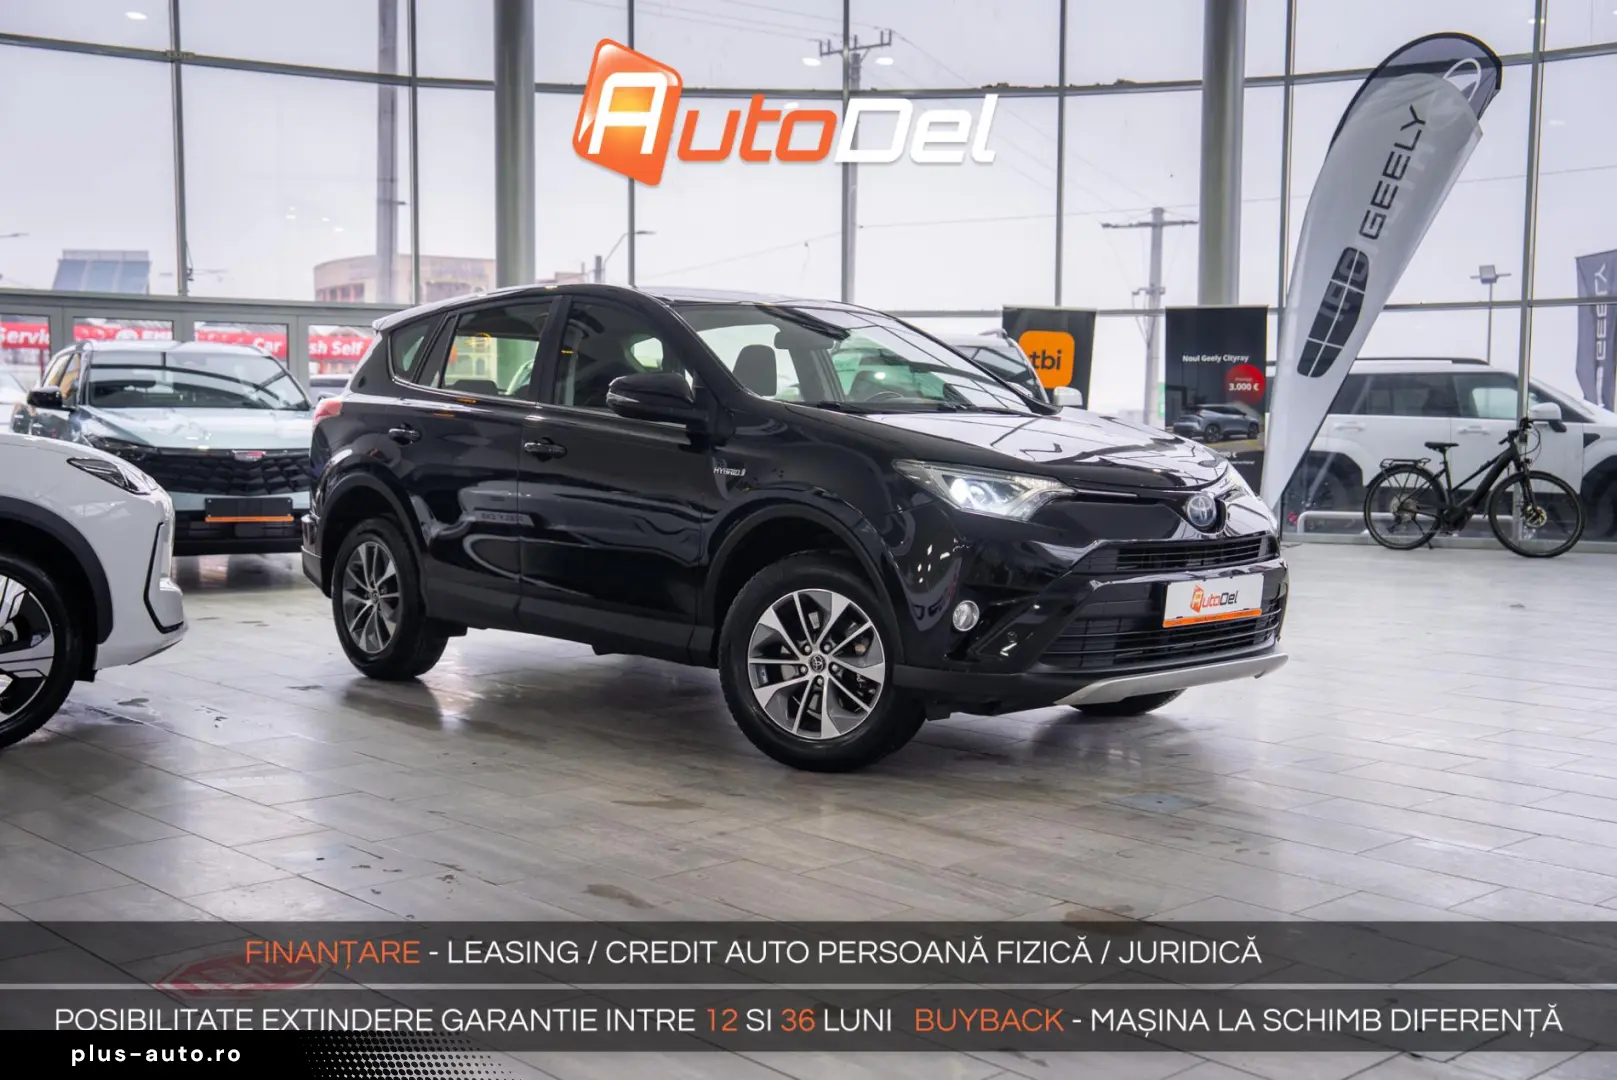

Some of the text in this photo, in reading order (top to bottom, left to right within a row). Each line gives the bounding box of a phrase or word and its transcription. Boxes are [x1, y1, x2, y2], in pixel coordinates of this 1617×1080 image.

[1359, 105, 1426, 241] GEELY
[1594, 262, 1608, 361] GEELY
[331, 341, 365, 356] Self
[1182, 354, 1250, 364] Noul Geely Cityray
[1029, 349, 1063, 371] tbi
[1228, 382, 1260, 392] 3.000 €
[1190, 589, 1239, 610] AutoDel
